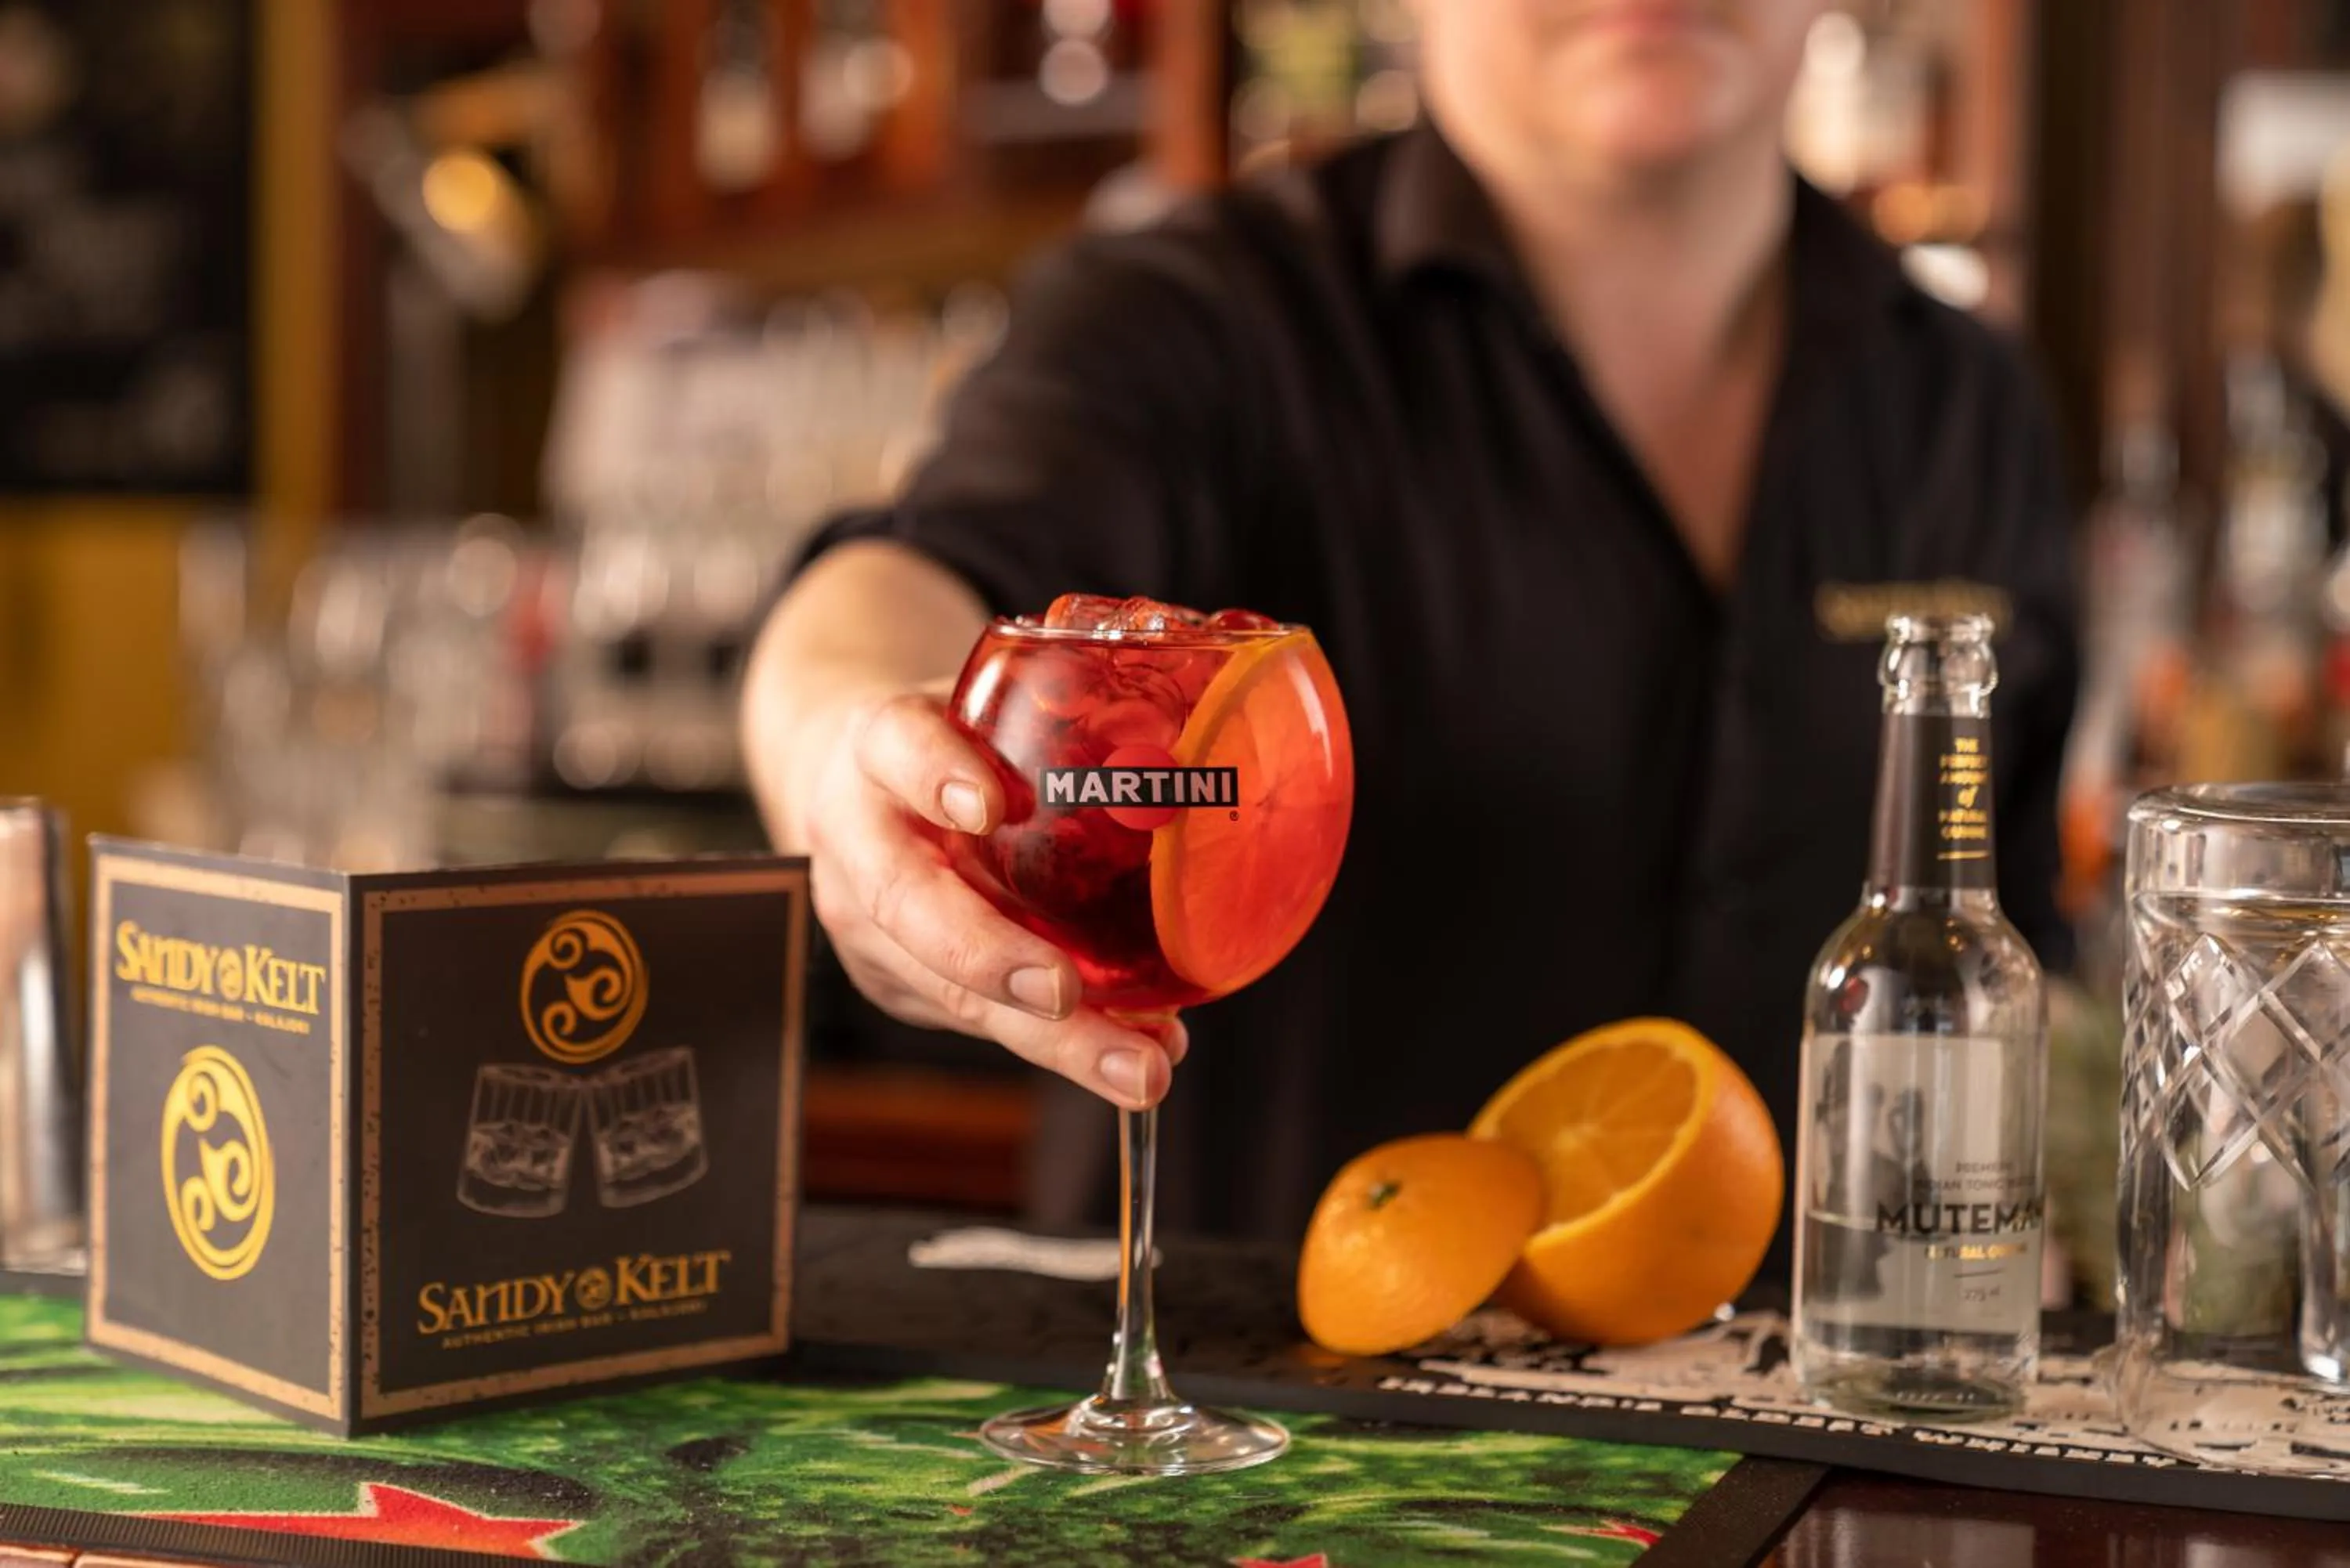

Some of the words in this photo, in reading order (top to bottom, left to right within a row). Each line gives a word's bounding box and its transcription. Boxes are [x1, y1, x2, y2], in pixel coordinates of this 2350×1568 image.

[1046, 771, 1231, 803] MARTINI
[116, 919, 216, 995] SANDY
[244, 945, 325, 1015] KELT
[418, 1270, 575, 1335] SANDY
[615, 1250, 732, 1306] KELT
